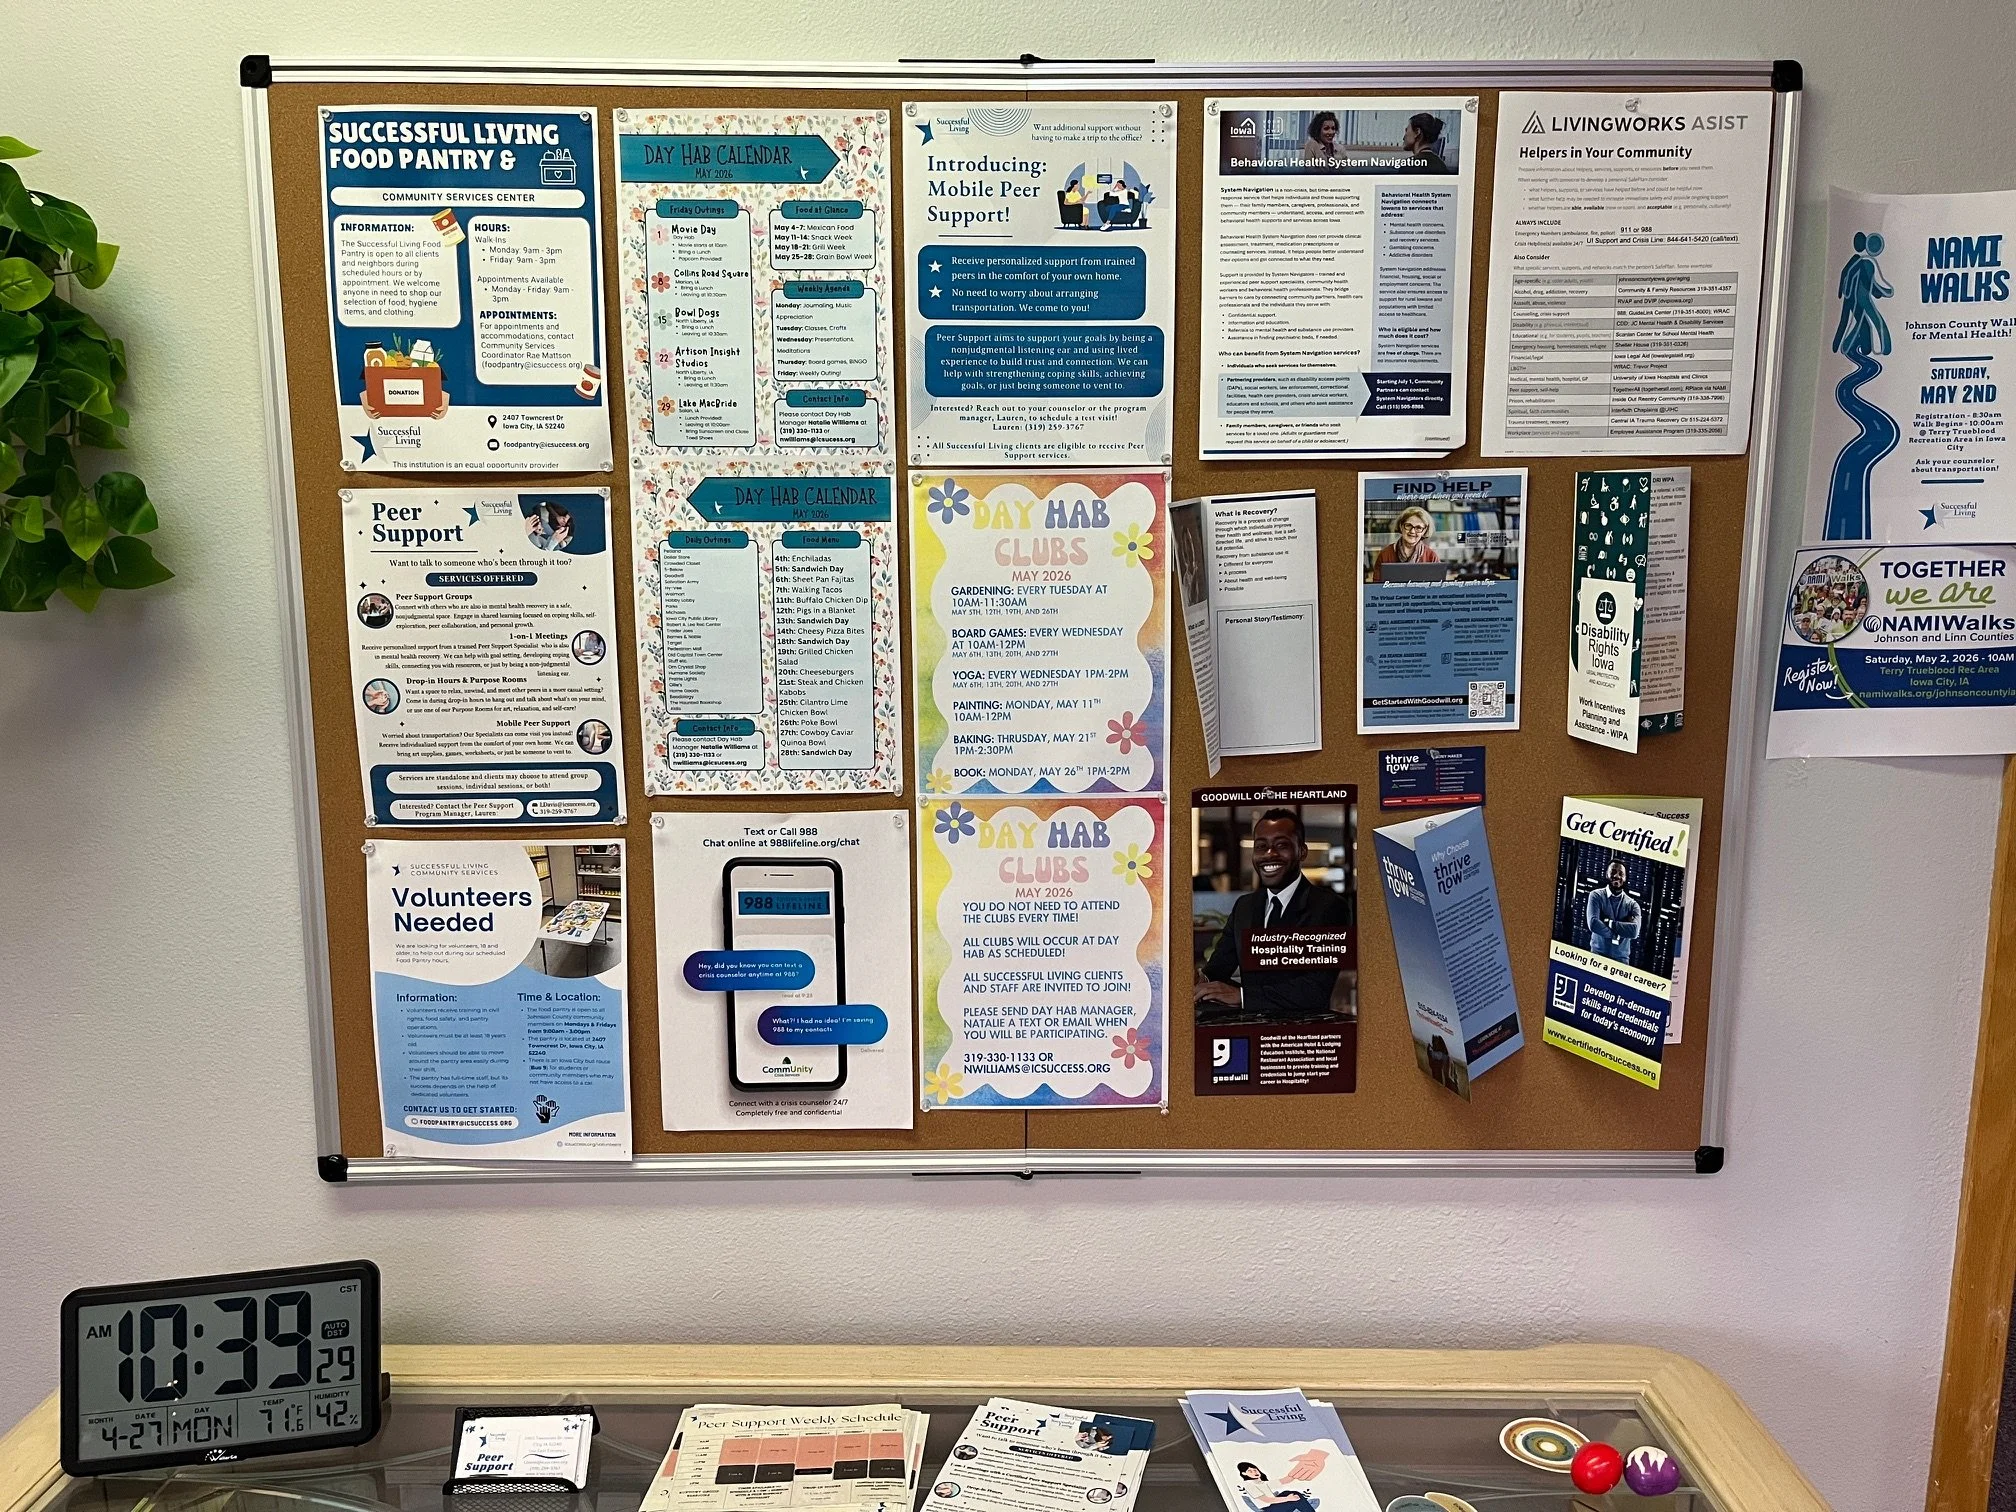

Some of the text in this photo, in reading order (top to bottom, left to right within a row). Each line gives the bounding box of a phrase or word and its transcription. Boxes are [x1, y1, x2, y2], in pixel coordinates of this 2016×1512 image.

[1552, 115, 1748, 132] LIVINGWORKS ASIST
[328, 121, 559, 145] SUCCESSFUL LIVING
[1230, 127, 1255, 135] Iowa
[330, 148, 516, 170] FOOD PANTRY &
[644, 144, 792, 166] DAY HAB CALENDAR
[1519, 146, 1692, 160] Helpers in Your Community
[928, 156, 1047, 178] Introducing:
[1230, 157, 1428, 170] Behavioral Health System Navigation
[695, 169, 733, 179] MAY 2026
[928, 181, 1040, 197] Mobile Peer
[382, 192, 535, 203] COMMUNITY SERVICES CENTER
[928, 206, 1010, 228] Support!
[341, 223, 414, 233] INFORMATION:
[474, 223, 510, 233] HOURS:
[774, 224, 790, 232] May
[1595, 237, 1618, 245] Support
[1927, 235, 2002, 269] NAMI
[1921, 270, 2010, 304] WALKS
[479, 311, 557, 320] APPOINTMENTS:
[1905, 321, 1946, 331] Johnson
[1949, 320, 1988, 330] County
[1912, 329, 2012, 341] for Mental Health!
[1931, 367, 1990, 380] SATURDAY,
[1921, 384, 1997, 404] MAY 2ND
[1025, 423, 1046, 431] (319)
[1393, 481, 1492, 494] FIND HELP
[372, 503, 422, 522] Peer
[972, 500, 1110, 529] DAY HAB
[373, 524, 463, 547] Support
[995, 537, 1088, 566] CLUBS
[792, 555, 832, 563] Enchiladas
[1880, 560, 2006, 578] TOGETHER
[439, 575, 524, 583] SERVICES OFFERED
[1885, 582, 1997, 605] we are
[1225, 616, 1253, 624] Personal
[1883, 615, 2015, 631] NAMIWalks
[1581, 623, 1630, 646] Disability
[1874, 634, 1919, 643] Johnson
[1945, 633, 1969, 641] Linn
[1970, 633, 2014, 641] Counties
[1588, 638, 1620, 657] Rights
[1592, 653, 1614, 671] Iowa
[1784, 658, 1837, 686] Register
[1806, 674, 1838, 693] Now!
[1372, 697, 1463, 706] GetStartedWithGoodwill.org
[953, 734, 994, 743] BAKING:
[997, 734, 1050, 743] THRUSDAY,
[1053, 733, 1076, 742] MAY
[1201, 793, 1251, 801] GOODWILL
[1254, 792, 1266, 800] OF
[1290, 790, 1347, 799] HEARTLAND
[744, 828, 765, 836] Text
[780, 828, 797, 836] Call
[799, 828, 817, 836] 988
[1566, 812, 1686, 857] Get Certified!
[703, 839, 725, 847] Chat
[727, 839, 755, 847] online
[770, 838, 860, 848] 988lifeline.org/chat
[1434, 853, 1471, 878] thrive
[1438, 873, 1463, 895] now
[392, 888, 532, 907] Volunteers
[744, 897, 773, 909] 988
[395, 912, 494, 932] Needed
[1251, 932, 1346, 943] Industry-Recognized
[1251, 944, 1346, 955] Hospitality Training
[1260, 956, 1338, 965] and Credentials
[1555, 946, 1666, 992] Looking for a great career?
[396, 993, 457, 1002] Information:
[517, 993, 601, 1002] Time & Location:
[964, 1053, 1054, 1063] 319-330-1133 OR
[1547, 1028, 1656, 1080] www.certifiedforsuccess.org
[762, 1065, 813, 1075] CommUnity
[964, 1064, 1111, 1074] NWILLIAMS@ICSUCCESS.ORG
[324, 1321, 347, 1330] AUTO
[327, 1328, 343, 1336] DST
[86, 1284, 358, 1403] AM 10:39 CST
[317, 1346, 355, 1383] 29
[314, 1390, 350, 1400] HUMIDITY
[194, 1406, 210, 1414] DAY
[1240, 1404, 1303, 1416] Successful
[1268, 1410, 1307, 1422] Living
[698, 1412, 903, 1429] Peer Support Weekly Schedule
[986, 1411, 1019, 1425] Peer
[172, 1414, 232, 1444] MON
[980, 1416, 1041, 1437] Support
[102, 1421, 162, 1450] 4-27
[477, 1453, 504, 1462] Peer
[464, 1461, 514, 1473] Support
